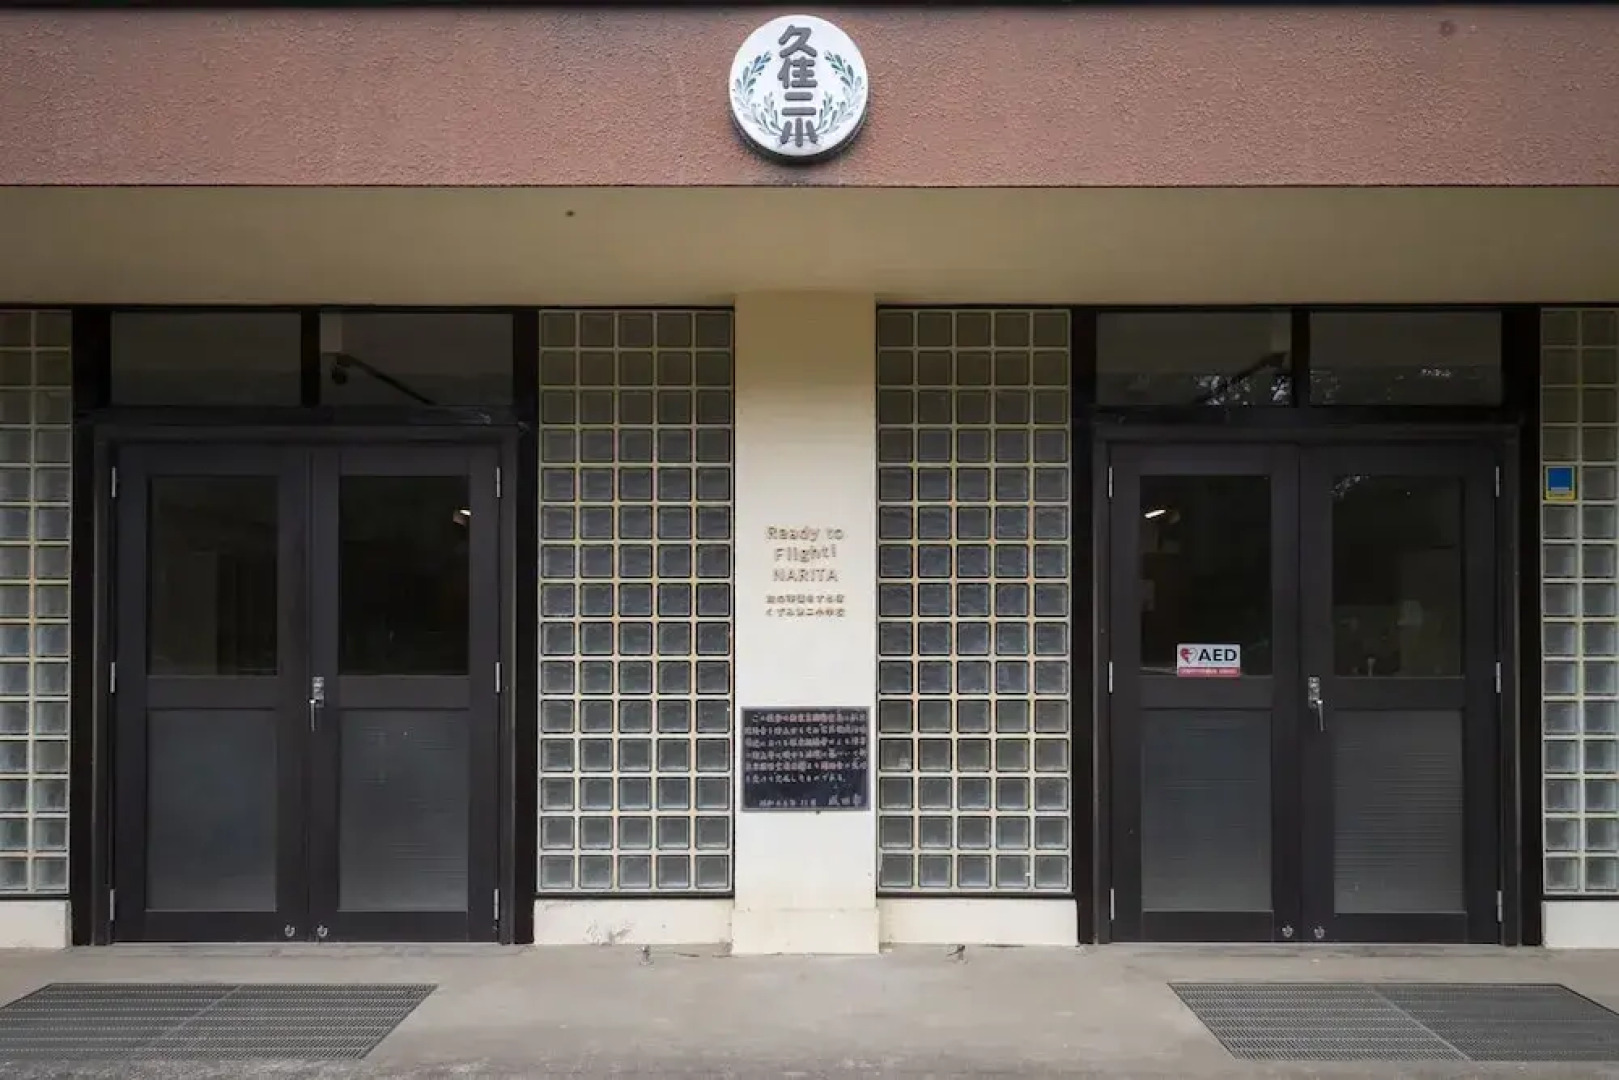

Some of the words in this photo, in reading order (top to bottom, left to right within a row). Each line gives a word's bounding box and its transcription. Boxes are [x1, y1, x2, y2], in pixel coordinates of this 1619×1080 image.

[777, 24, 818, 148] 久住二小
[766, 526, 820, 542] Ready
[827, 527, 845, 541] to
[773, 568, 839, 582] NARITA
[1198, 648, 1238, 662] AED
